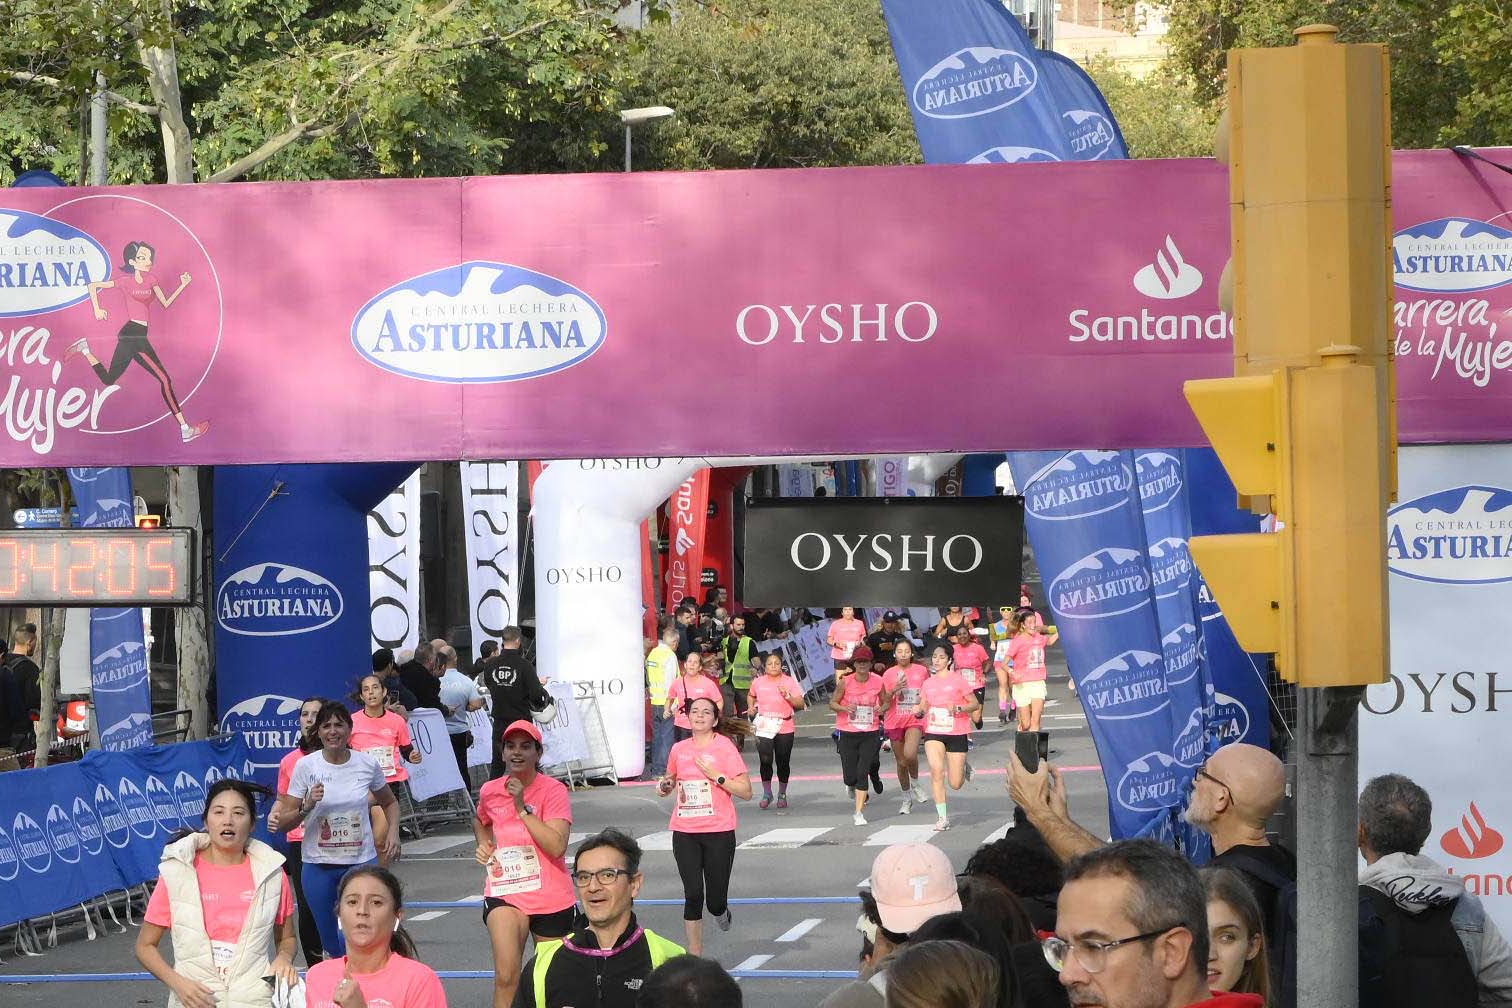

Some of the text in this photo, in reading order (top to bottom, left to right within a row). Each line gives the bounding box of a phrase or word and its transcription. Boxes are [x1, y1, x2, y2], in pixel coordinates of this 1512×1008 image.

[14, 244, 86, 256] LECHERA
[1408, 243, 1458, 252] CENTRAL
[410, 302, 578, 318] CENTRAL LECHERA
[1393, 298, 1491, 328] arrera
[371, 308, 587, 353] ASTURIANA
[736, 301, 938, 346] OYSHO
[1068, 308, 1233, 342] Santand
[1417, 328, 1436, 356] la
[1431, 323, 1512, 387] Muje
[1415, 520, 1482, 531] CENTRAL
[790, 531, 984, 573] OYSHO
[546, 565, 622, 586] OYSHO
[234, 587, 329, 596] CENTRAL LECHERA
[220, 592, 334, 620] ASTURIANA
[235, 719, 277, 728] CENTRAL
